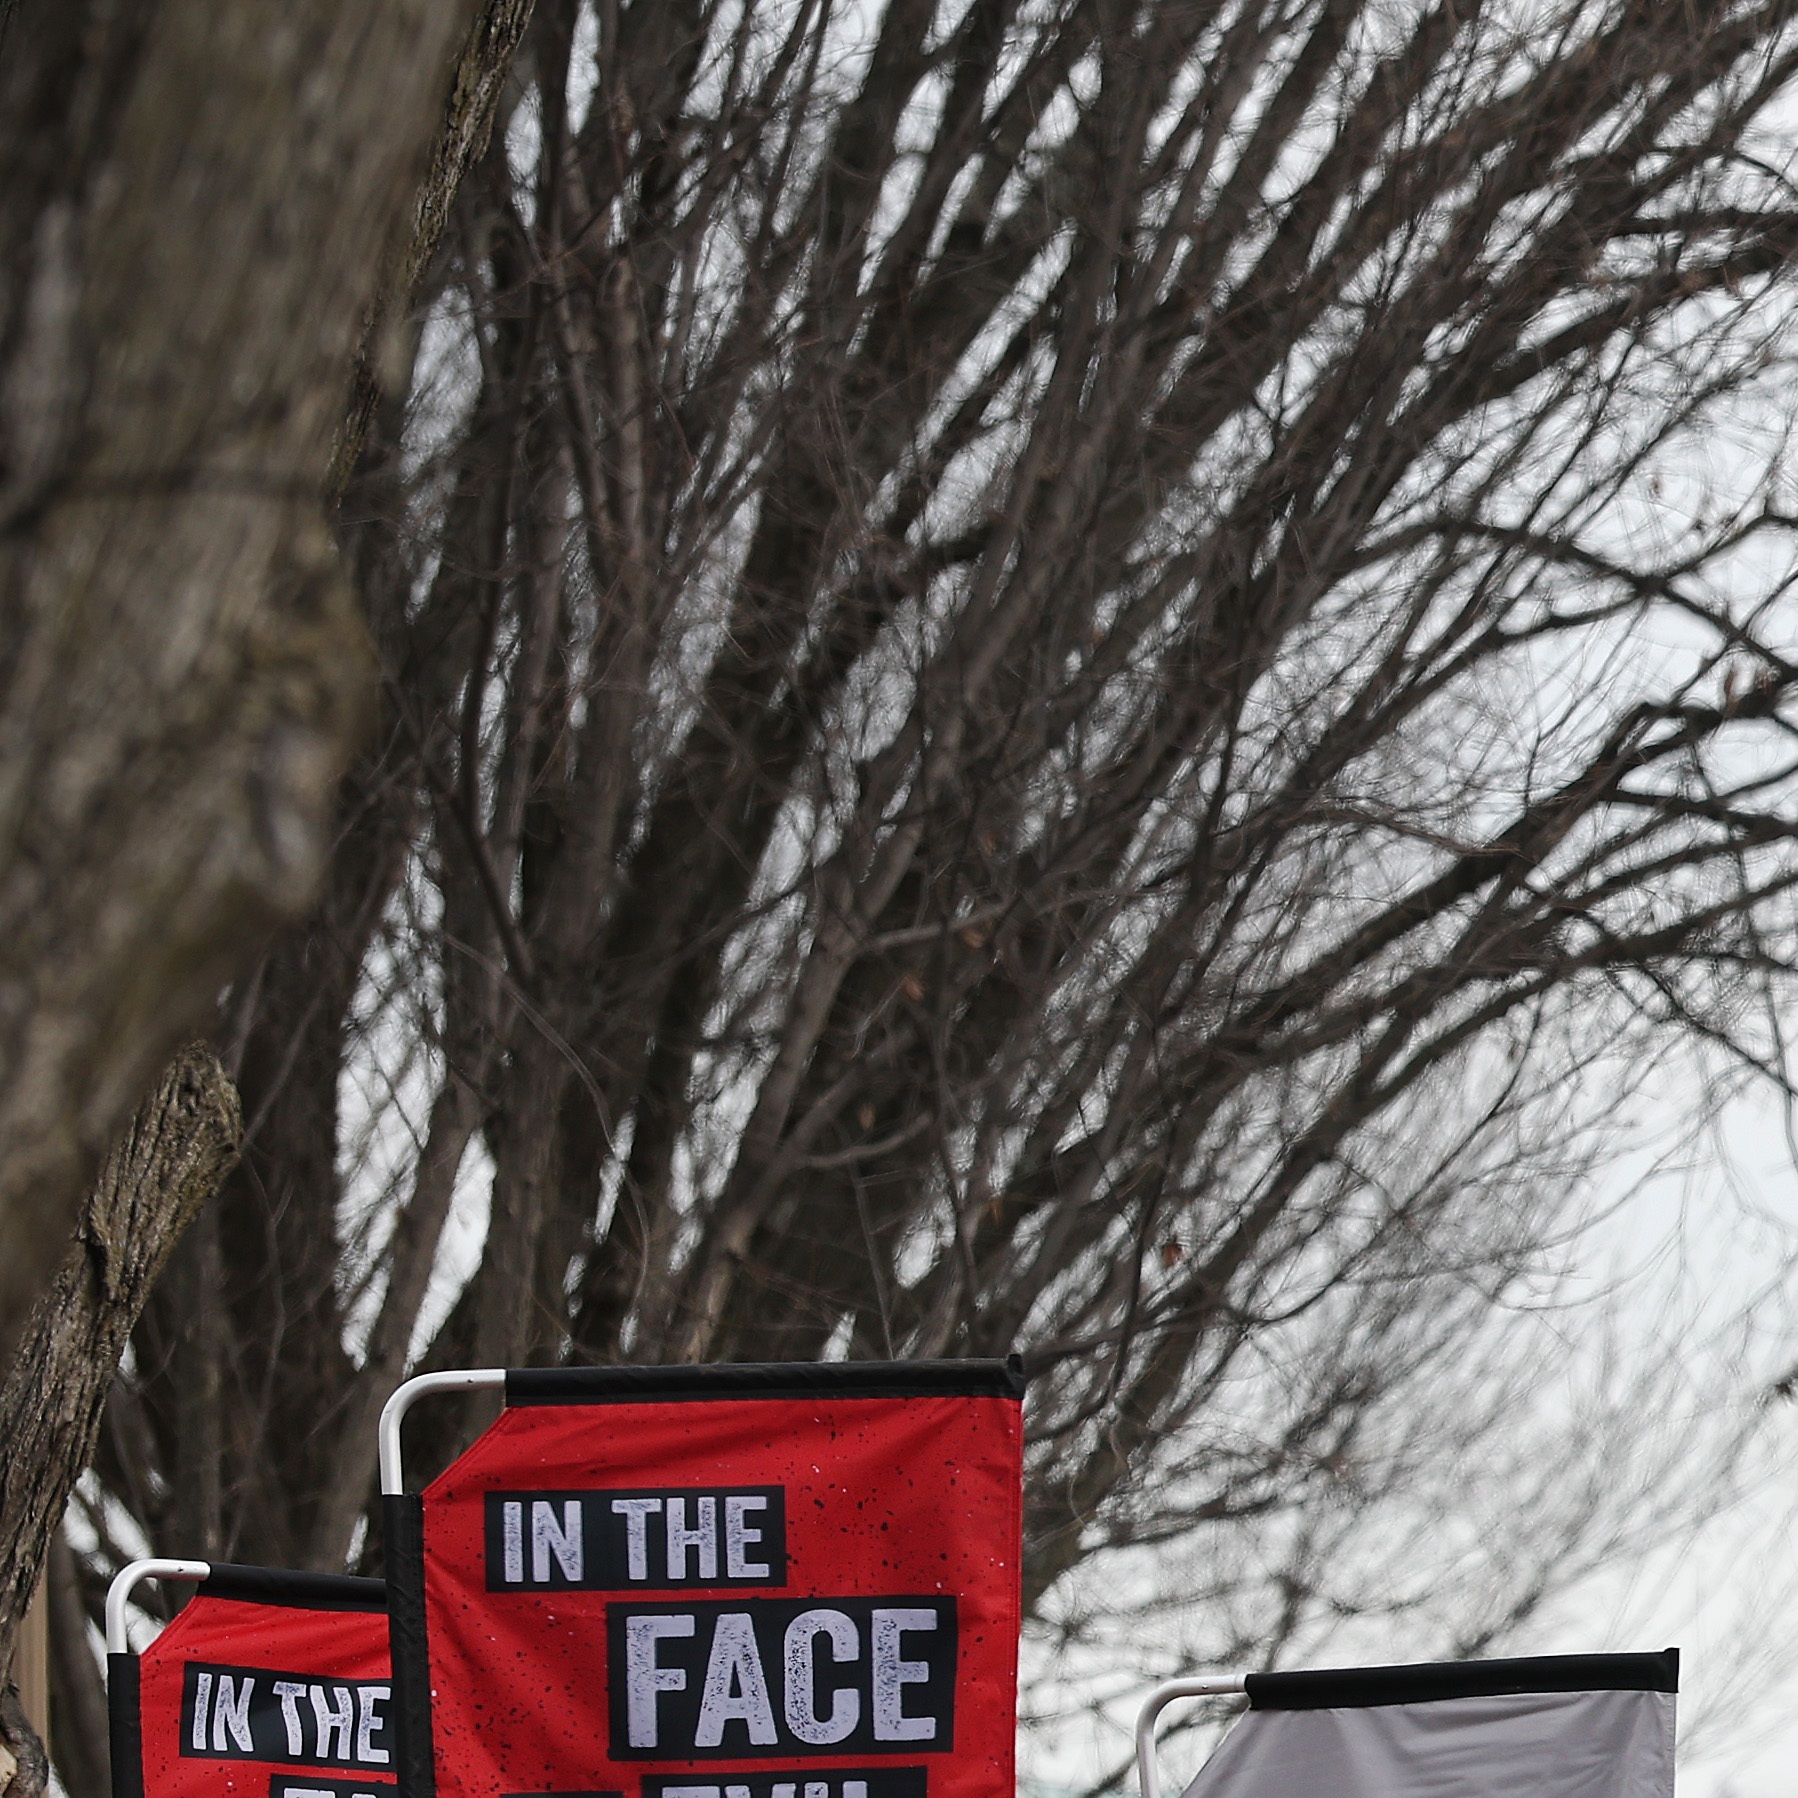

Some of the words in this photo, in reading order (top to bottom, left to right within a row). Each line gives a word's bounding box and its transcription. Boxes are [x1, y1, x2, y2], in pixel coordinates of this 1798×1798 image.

[503, 1500, 583, 1583] IN
[611, 1495, 770, 1580] THE
[192, 1672, 255, 1753] IN
[272, 1681, 392, 1764] THE
[626, 1608, 938, 1748] FACE
